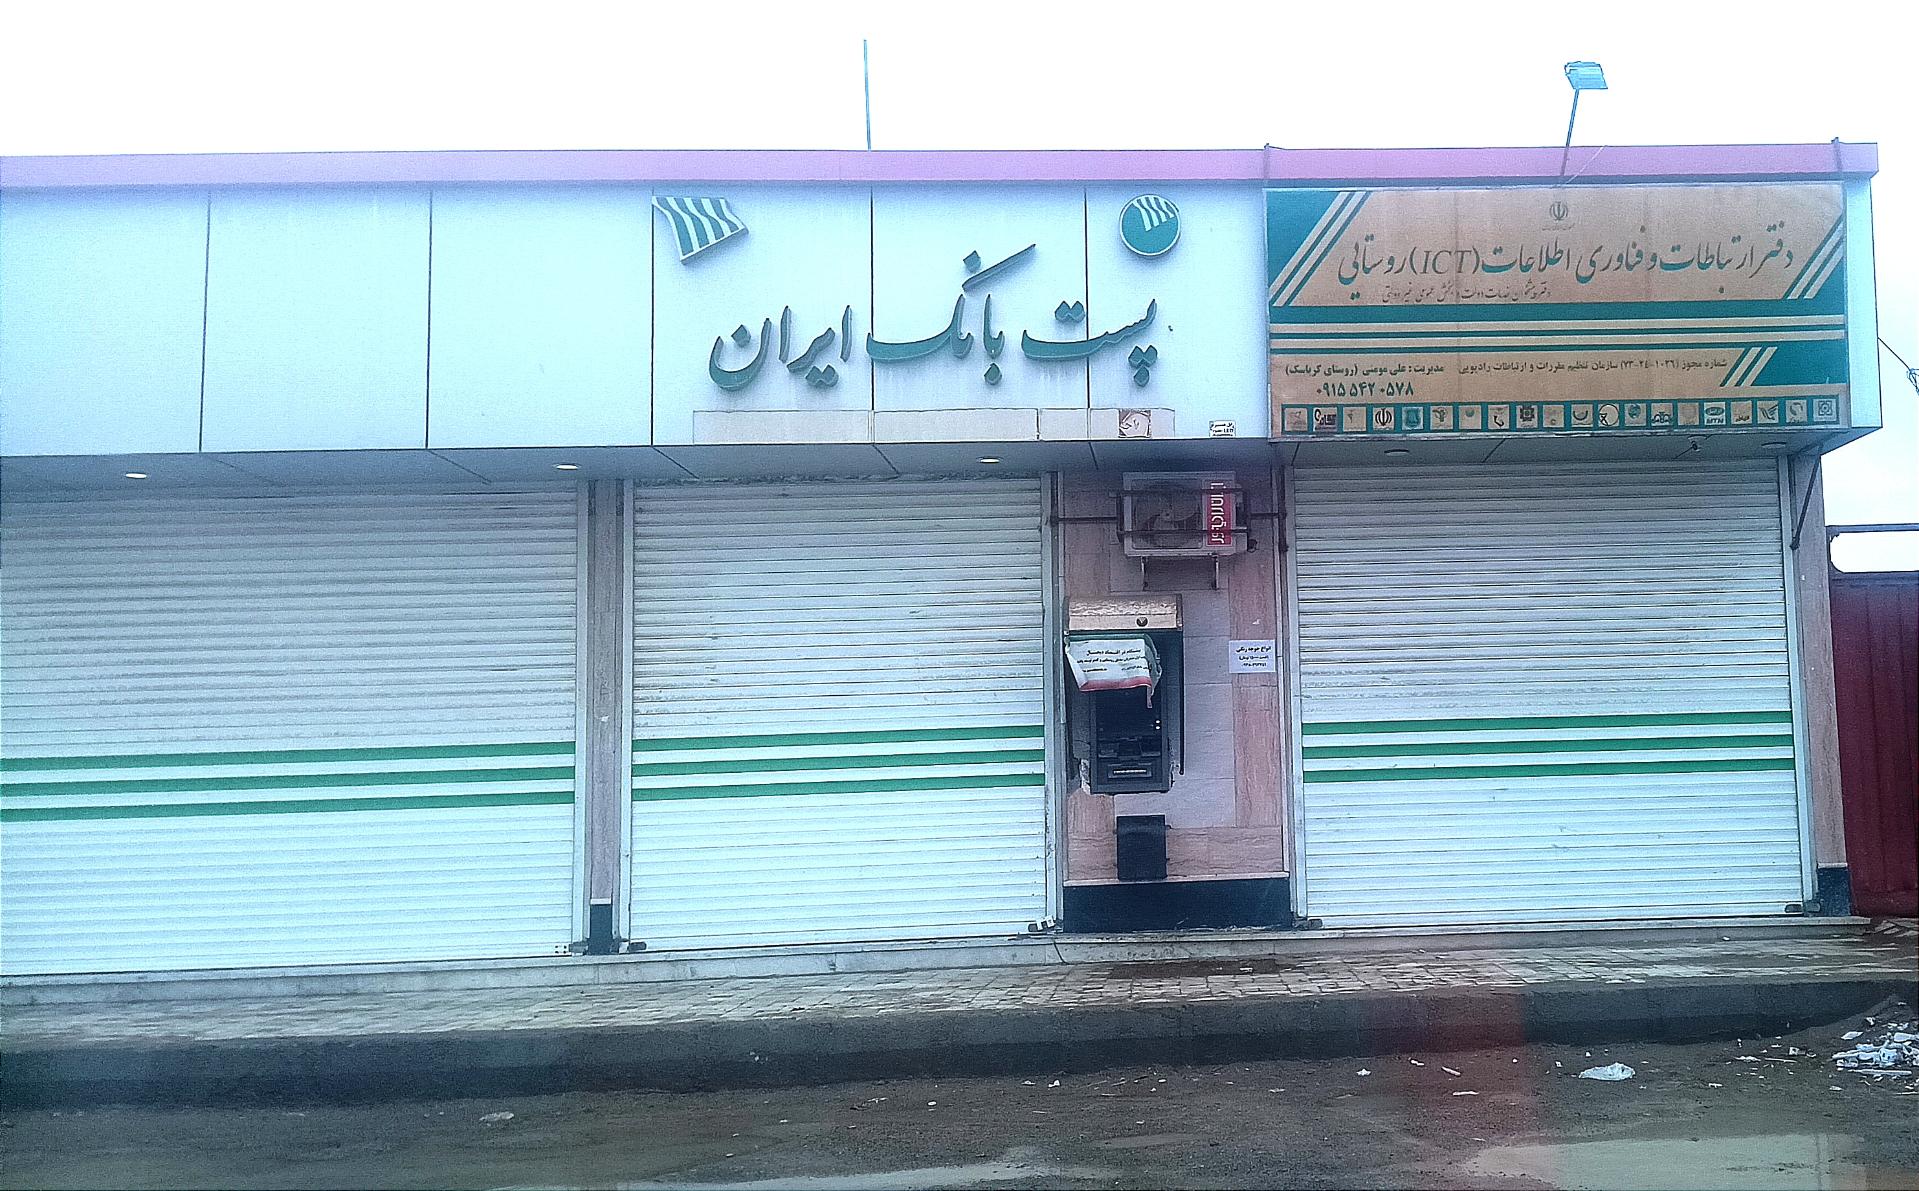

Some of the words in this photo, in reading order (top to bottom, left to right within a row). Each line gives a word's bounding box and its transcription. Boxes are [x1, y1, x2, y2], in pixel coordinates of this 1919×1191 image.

[1480, 235, 1572, 274] اطلاعات
[1575, 224, 1647, 285] فناوری
[1748, 220, 1794, 279] دفتر
[1647, 251, 1658, 272] و
[1659, 234, 1754, 294] ارتباطات
[866, 243, 1037, 386] بانک
[708, 304, 853, 391] ایران
[1021, 297, 1158, 387] پست
[1324, 363, 1358, 377] (روستای
[1389, 363, 1406, 377] علی
[1493, 361, 1527, 373] ارتباطات
[1529, 362, 1534, 373] و
[1536, 362, 1565, 373] مقررات
[1567, 361, 1588, 371] تنظیم
[1591, 360, 1618, 371] سازمان
[1681, 361, 1703, 371] مجوز
[1704, 359, 1728, 370] شماره
[1316, 381, 1346, 397] ۰۹۱۵
[1349, 380, 1376, 397] ۵۴۲
[1380, 380, 1414, 397] ۰۵۷۸
